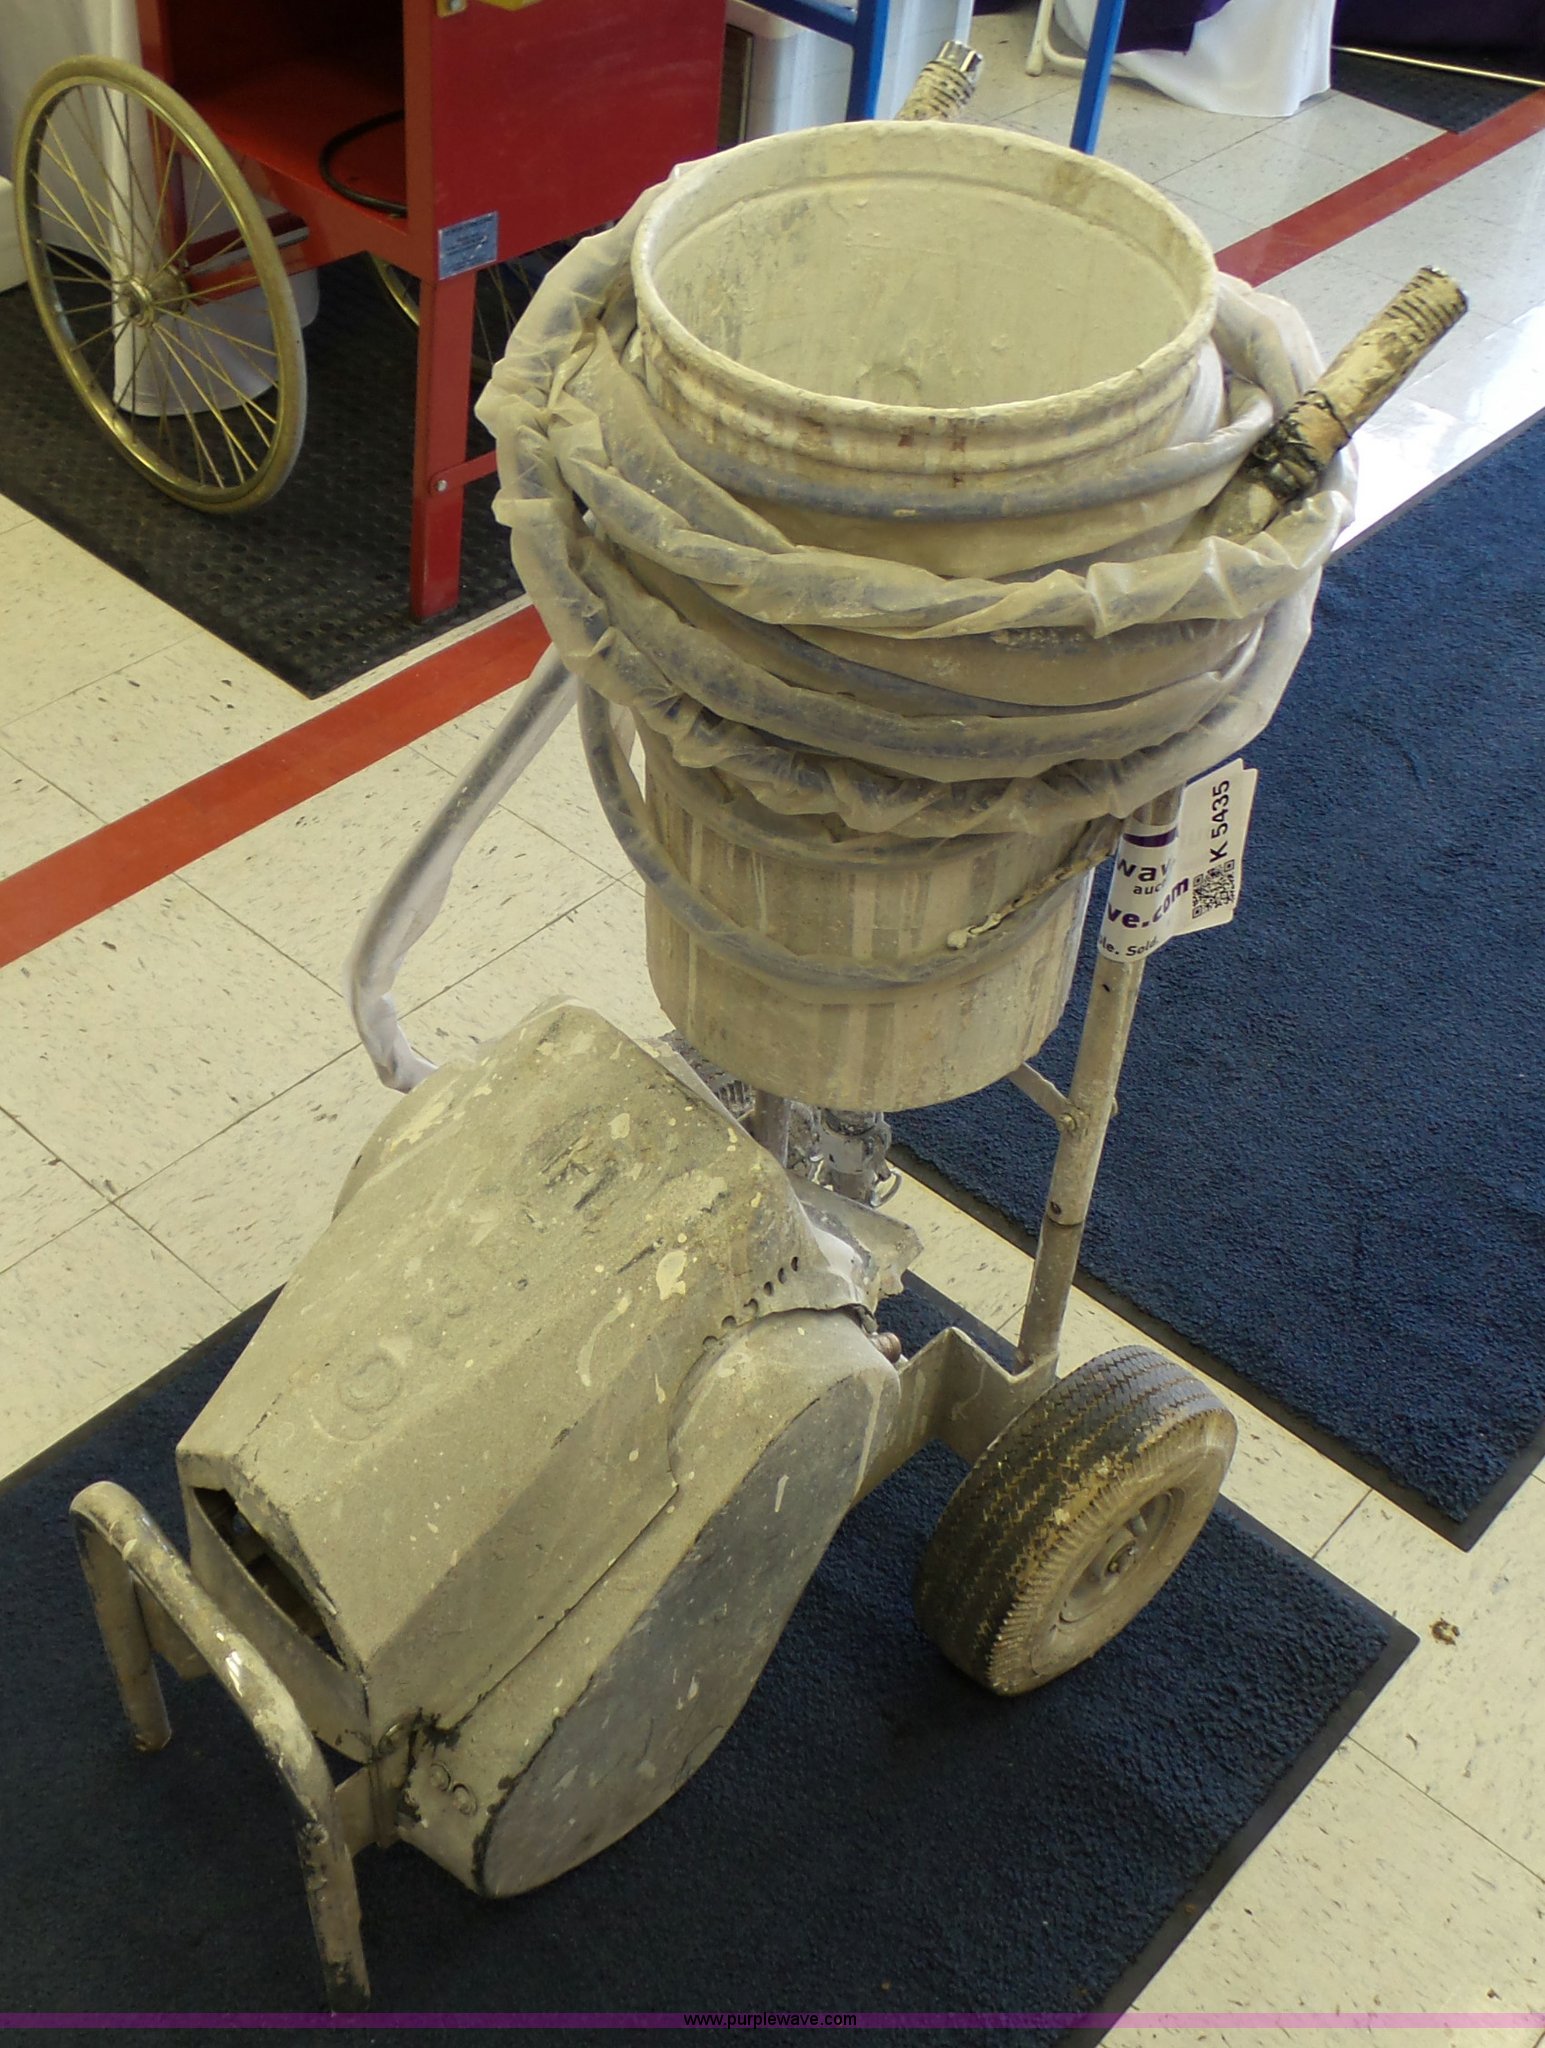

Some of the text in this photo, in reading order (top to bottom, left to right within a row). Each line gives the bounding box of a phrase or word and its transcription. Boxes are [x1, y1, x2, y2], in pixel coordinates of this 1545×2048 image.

[1209, 780, 1230, 863] K 5435
[1107, 877, 1189, 928] ve.com
